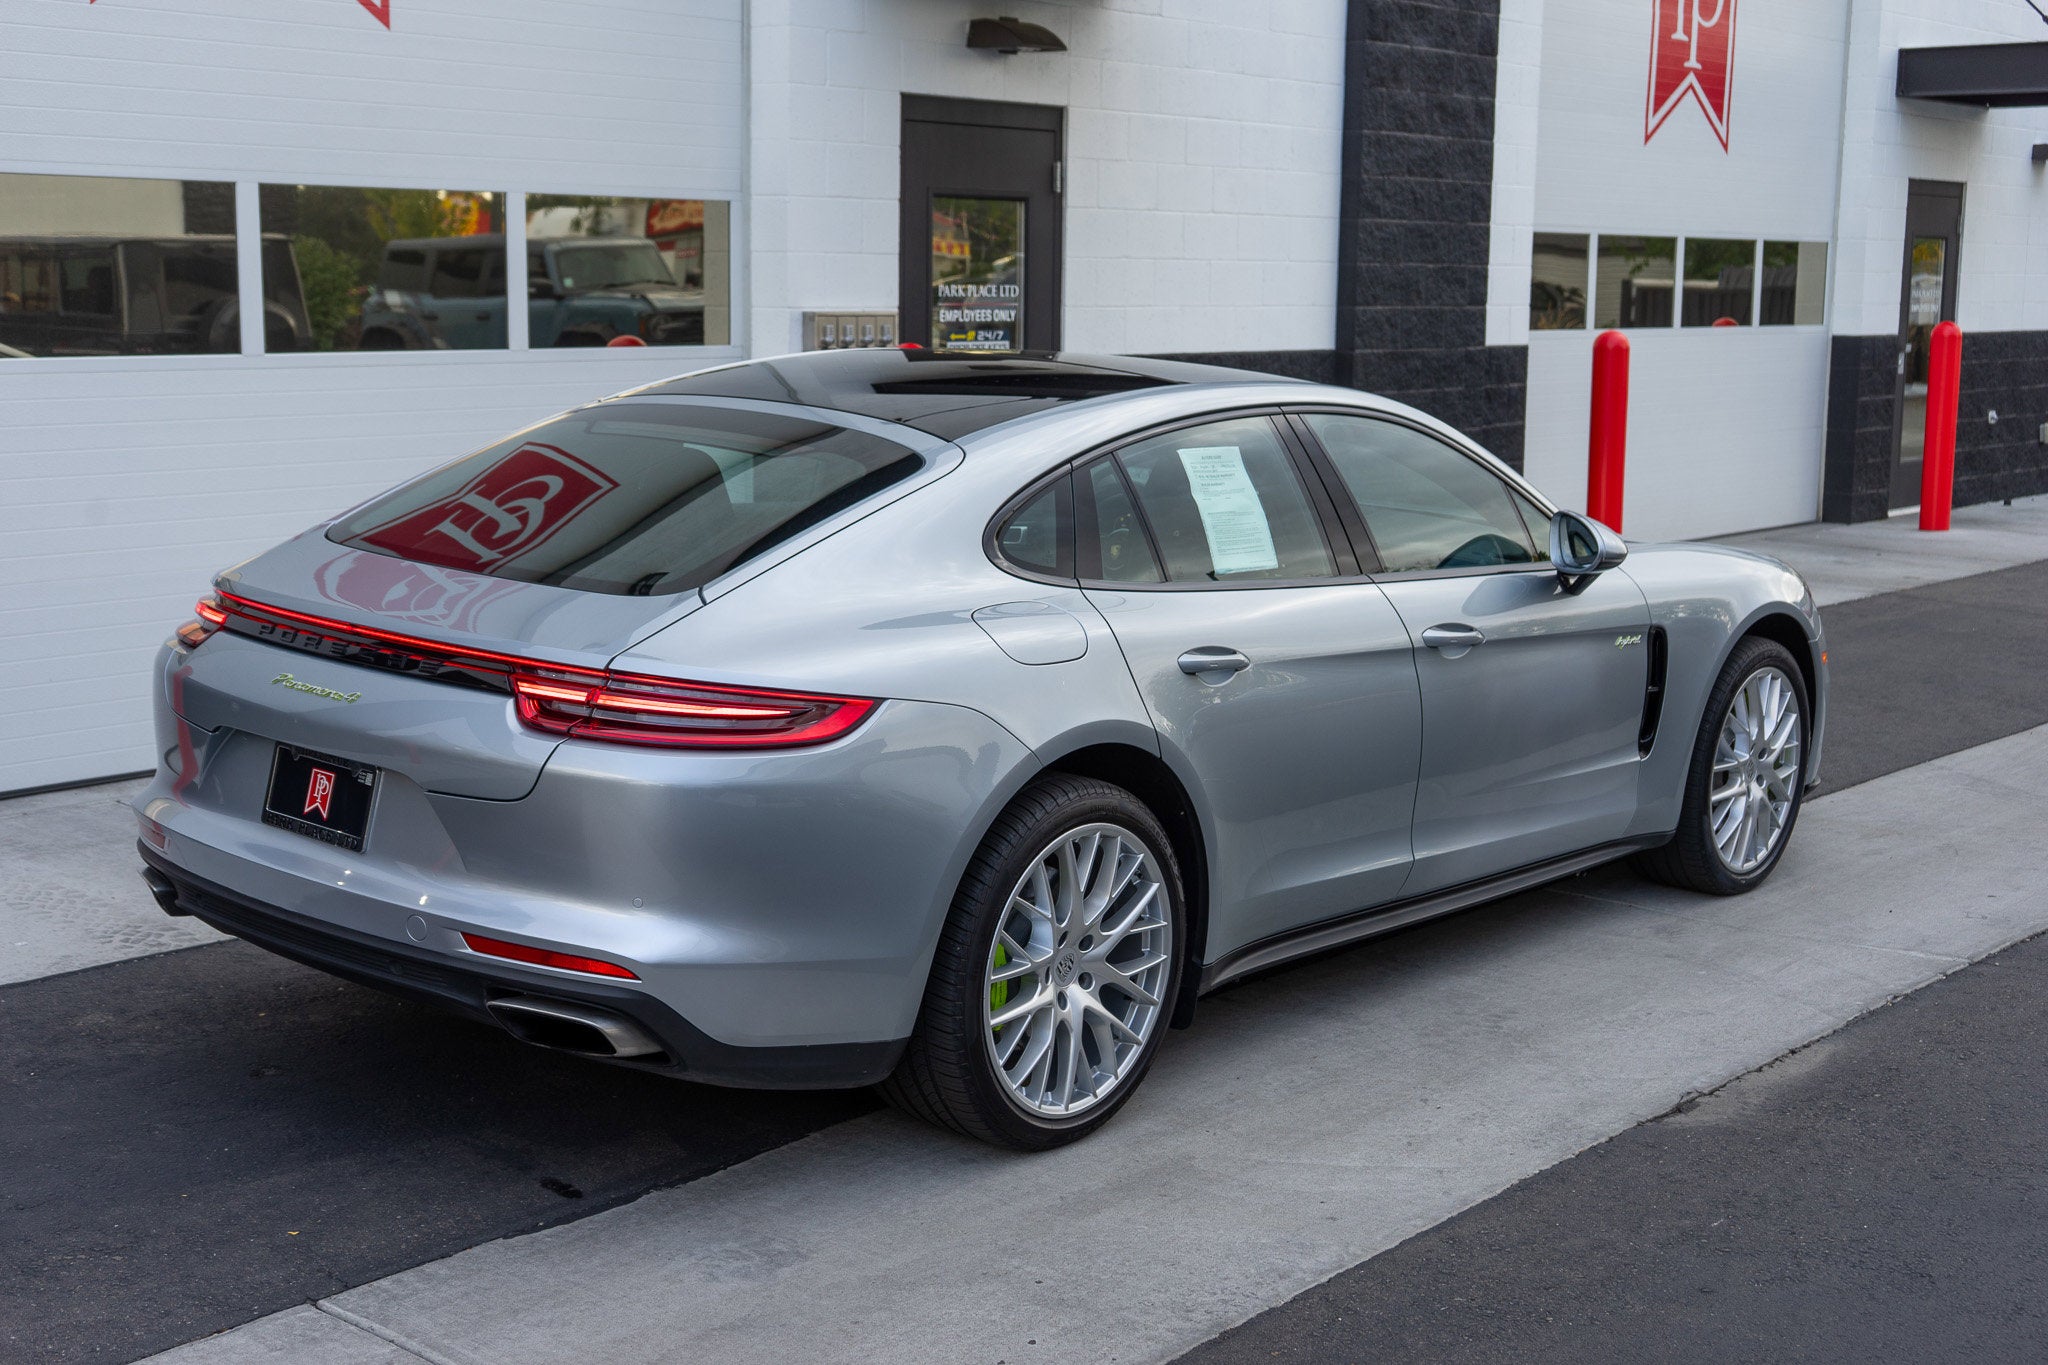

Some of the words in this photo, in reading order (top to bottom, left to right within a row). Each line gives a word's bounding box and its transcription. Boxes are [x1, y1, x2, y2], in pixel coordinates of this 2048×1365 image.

[938, 284, 966, 298] PARK
[967, 284, 997, 298] PLACE
[999, 285, 1020, 298] LTD
[939, 309, 992, 323] EMPLOYEES
[993, 309, 1016, 322] ONLY
[977, 330, 1004, 341] 24/7
[272, 673, 343, 701] Panamera
